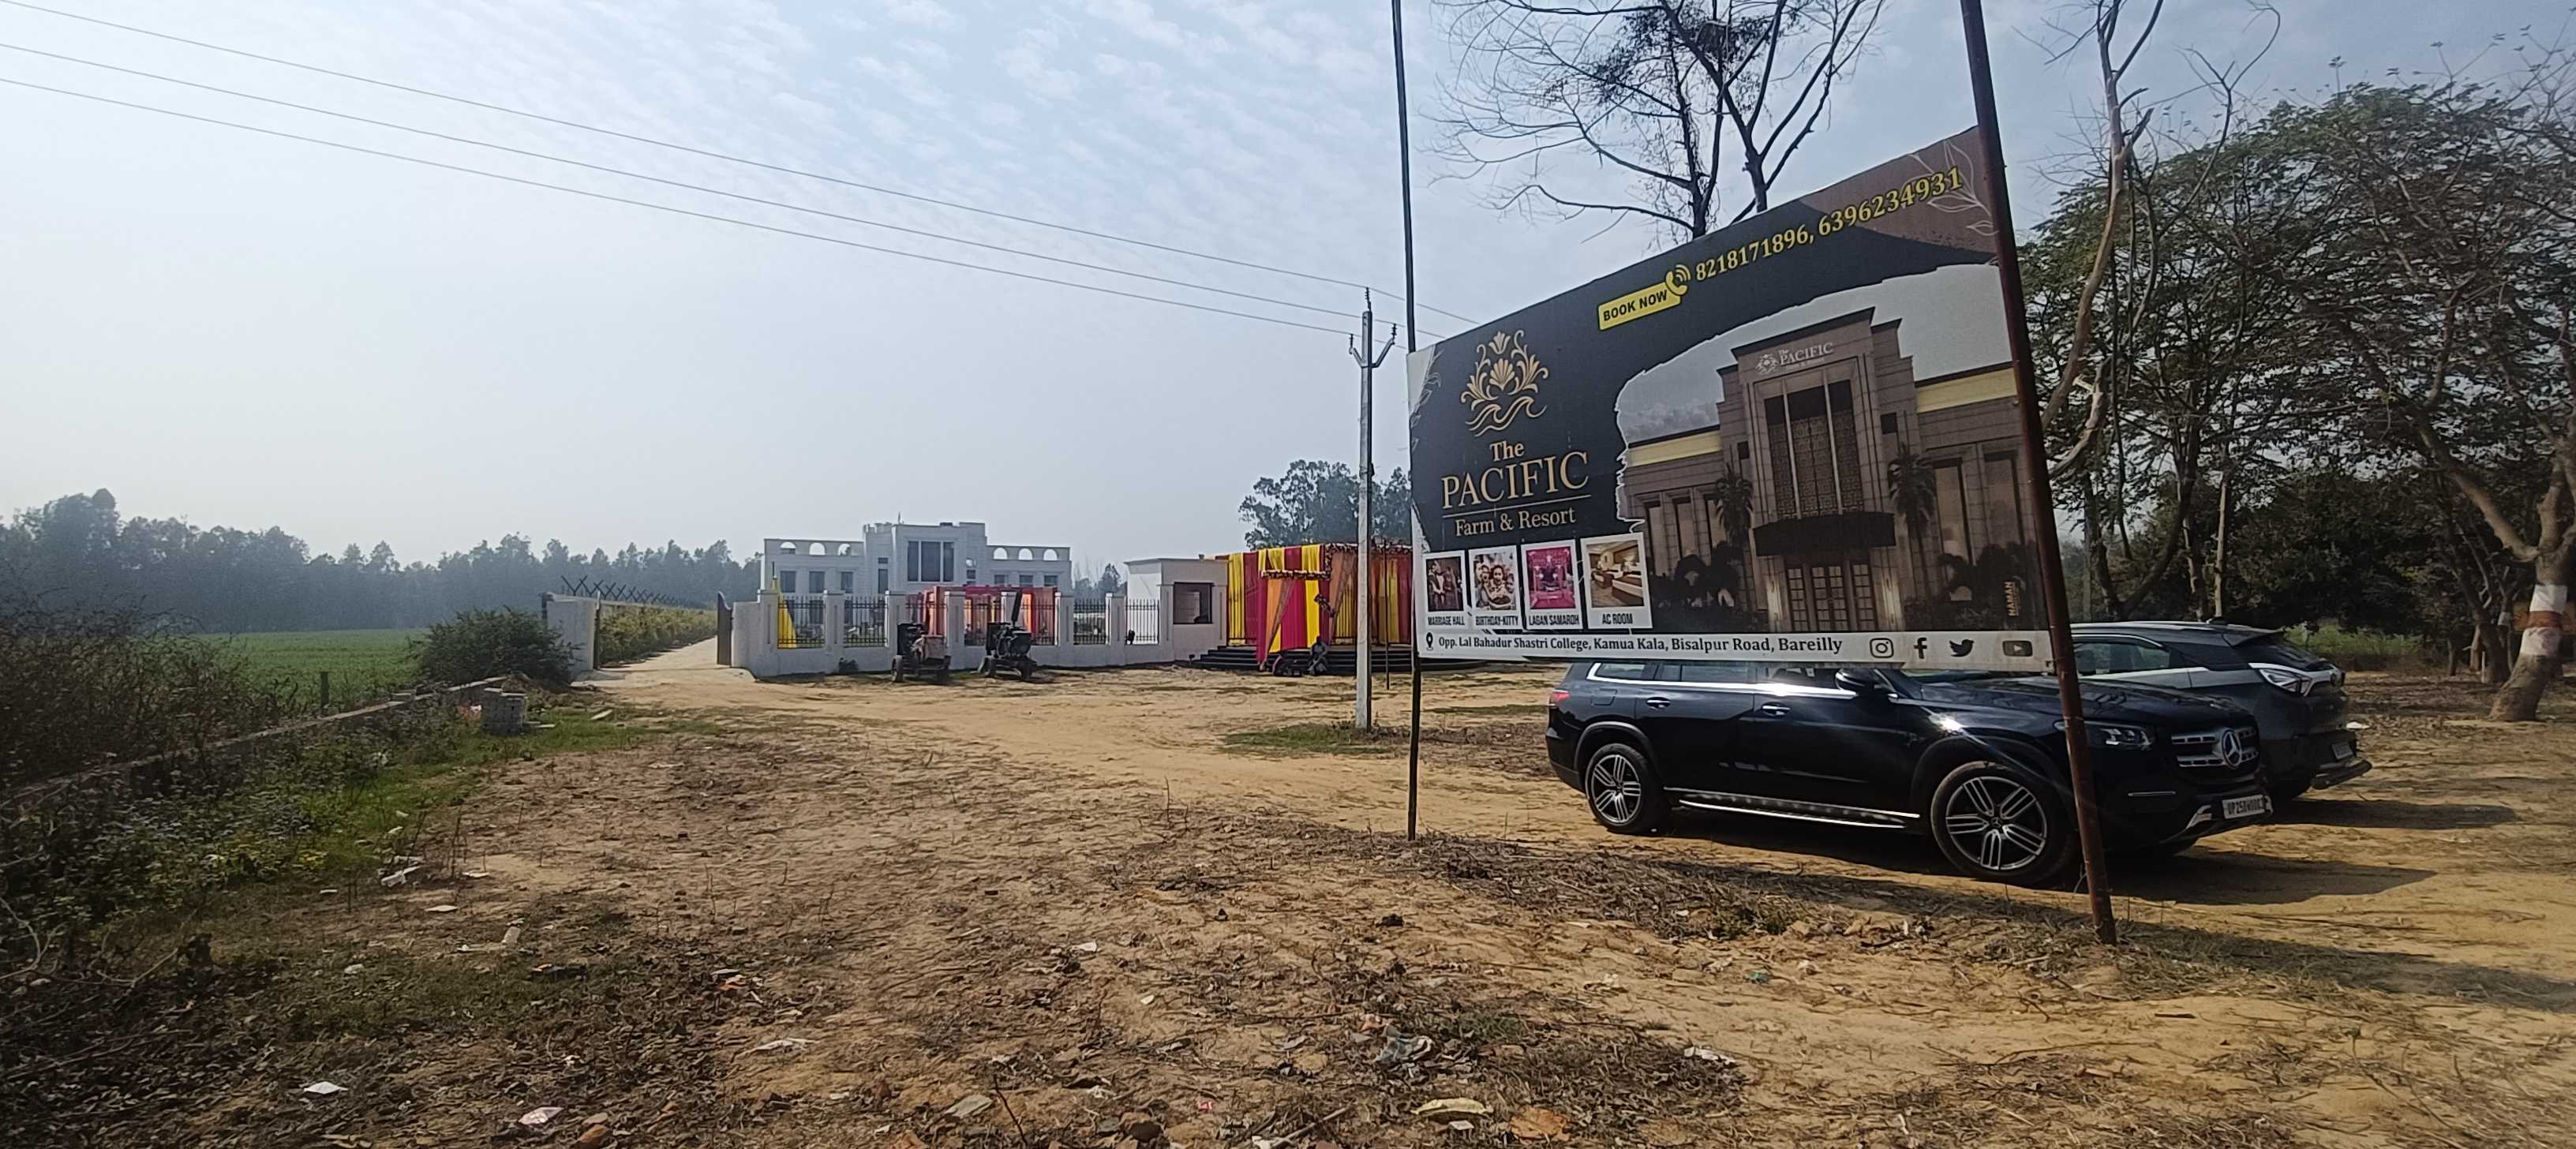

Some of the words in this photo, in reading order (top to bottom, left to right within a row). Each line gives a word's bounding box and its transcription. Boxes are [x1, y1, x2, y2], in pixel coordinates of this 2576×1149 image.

[1696, 224, 1814, 280] 8218171896,
[1818, 167, 1963, 236] 6396234931
[1603, 299, 1636, 322] BOOK
[1638, 290, 1668, 309] NOW
[1780, 342, 1833, 365] PACIFIC
[1489, 440, 1525, 462] The
[1440, 451, 1589, 509] PACIFIC
[1455, 518, 1494, 536] Farm
[1500, 513, 1514, 530] &
[1519, 507, 1576, 529] Resort
[1428, 616, 1451, 626] MARRIAGE
[1453, 616, 1465, 625] HALL
[1529, 616, 1548, 625] LAGAN
[1602, 614, 1611, 624] AC
[1612, 613, 1633, 624] ROOM
[1439, 637, 1458, 649] Opp.
[1459, 637, 1472, 647] Lal
[1473, 637, 1512, 648] Bahadur
[1514, 637, 1548, 649] Shastri
[1550, 638, 1591, 651] College,
[1594, 638, 1634, 649] Kamua
[1637, 638, 1668, 651] Kala,
[1672, 638, 1728, 653] Bisalpur
[1733, 638, 1775, 653] Road,
[1779, 637, 1843, 654] Bareilly
